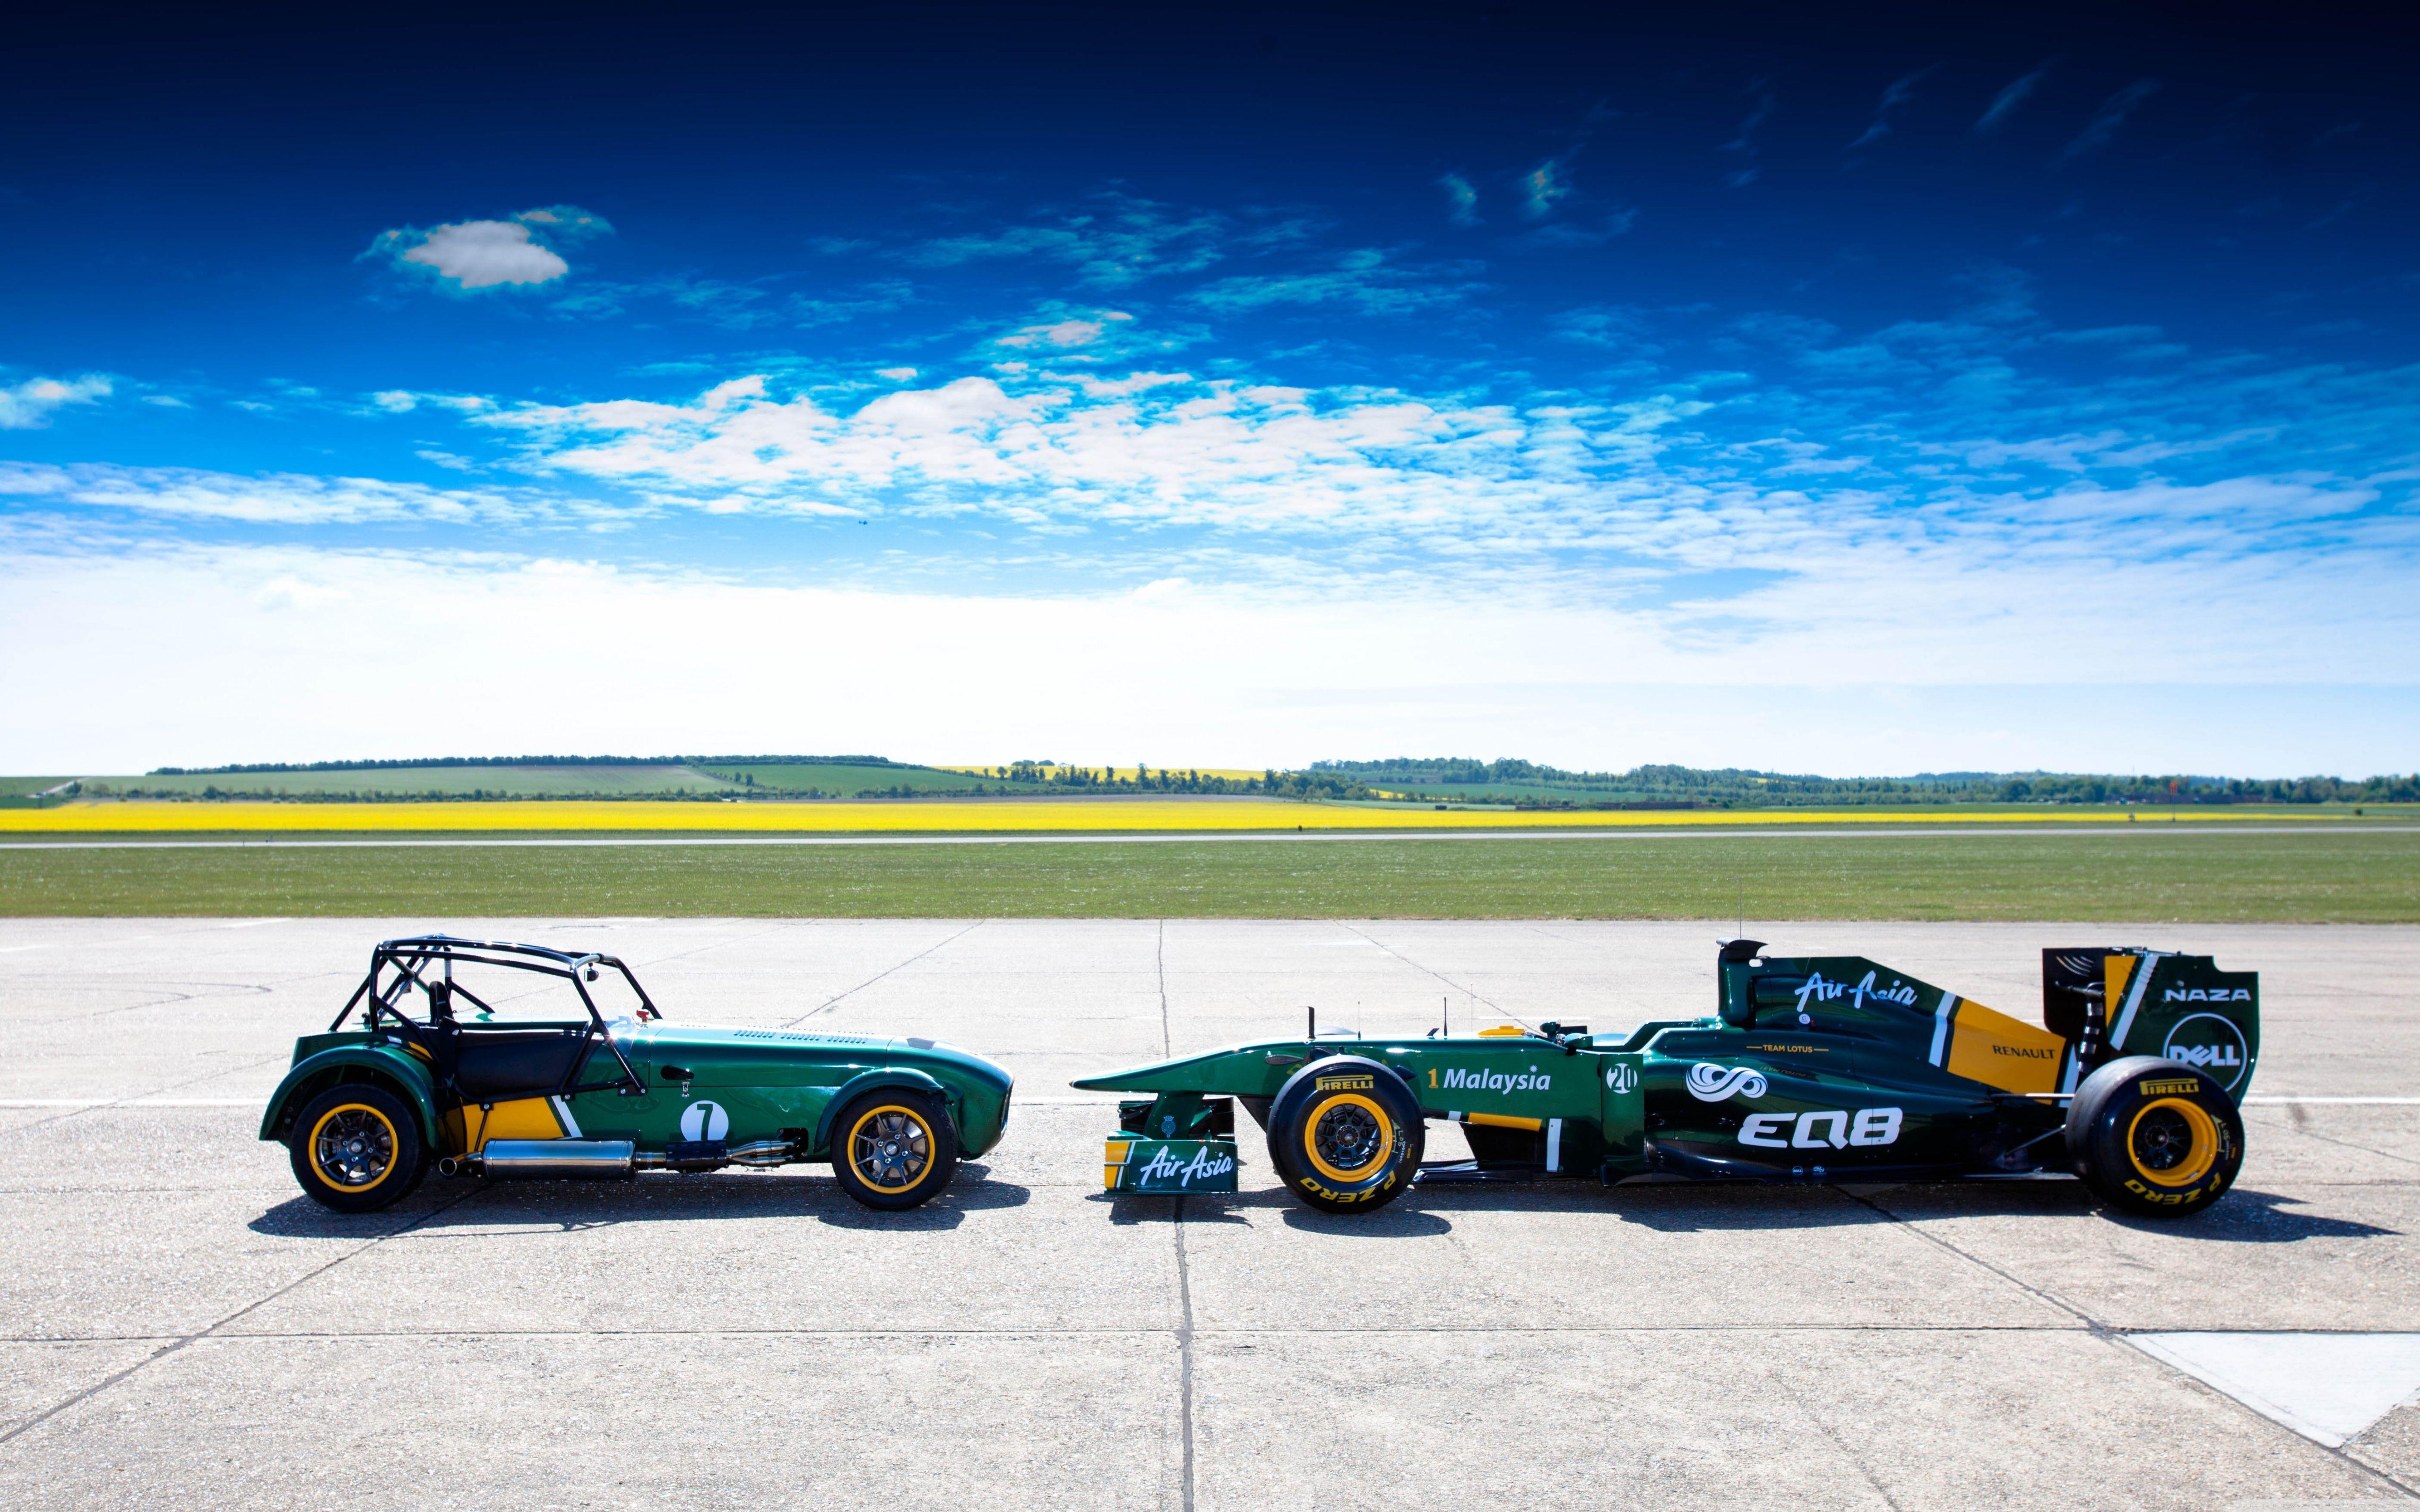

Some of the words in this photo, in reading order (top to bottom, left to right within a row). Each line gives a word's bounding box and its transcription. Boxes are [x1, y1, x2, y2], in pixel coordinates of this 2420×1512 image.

[2164, 989, 2252, 1001] NAZA
[1787, 1045, 1813, 1053] LOTUS
[1992, 1044, 2056, 1059] RENAULT
[2169, 1044, 2241, 1067] DELL
[1316, 1074, 1374, 1091] PIRELLI
[2139, 1078, 2200, 1095] PIRELLI
[697, 1104, 713, 1141] 7
[1737, 1107, 1903, 1150] EQ8
[1300, 1177, 1376, 1203] ZERO
[1383, 1170, 1396, 1191] P
[2209, 1172, 2221, 1192] P
[2124, 1179, 2202, 1204] ZERO
